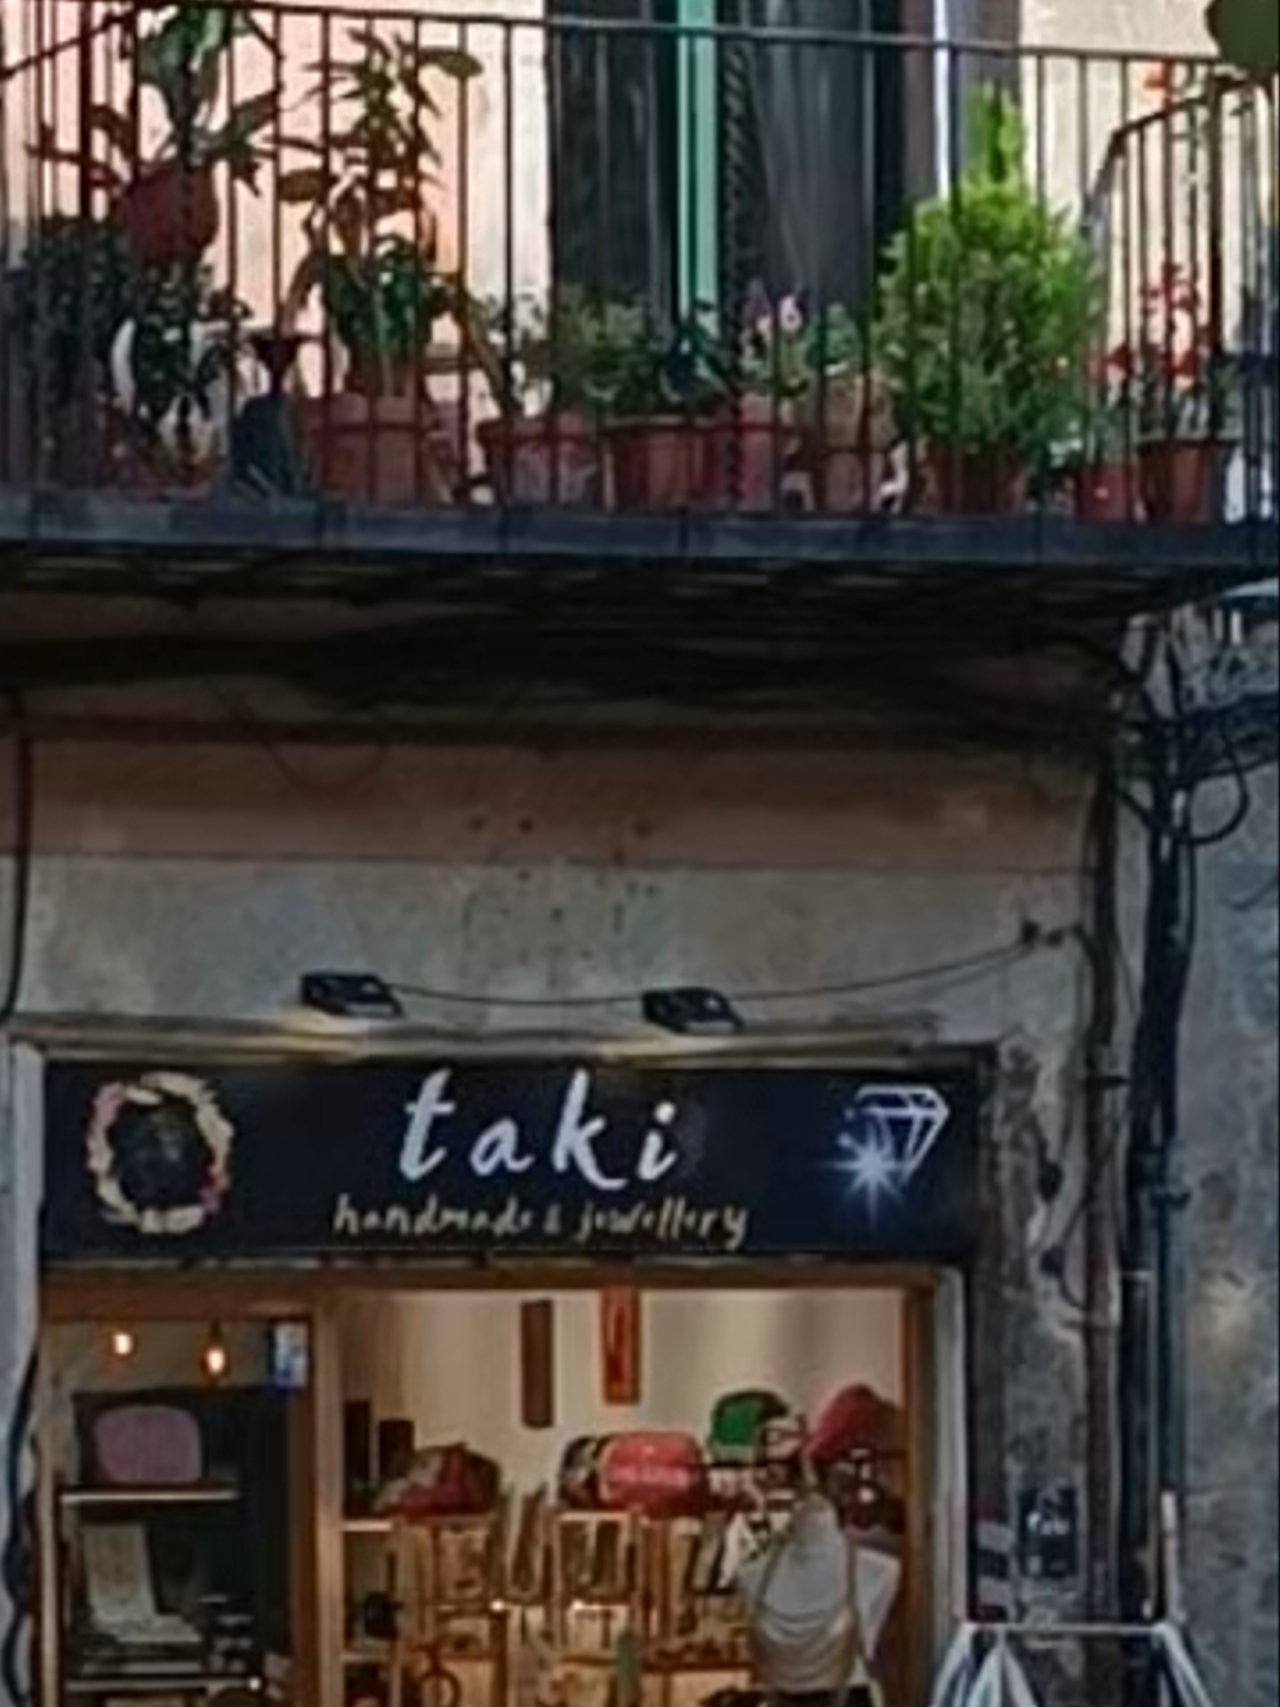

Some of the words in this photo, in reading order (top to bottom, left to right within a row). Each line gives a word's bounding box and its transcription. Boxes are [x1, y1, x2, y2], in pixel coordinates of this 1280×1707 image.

[399, 1068, 677, 1190] taki
[333, 1194, 532, 1235] handmade
[576, 1196, 748, 1250] jewellery
